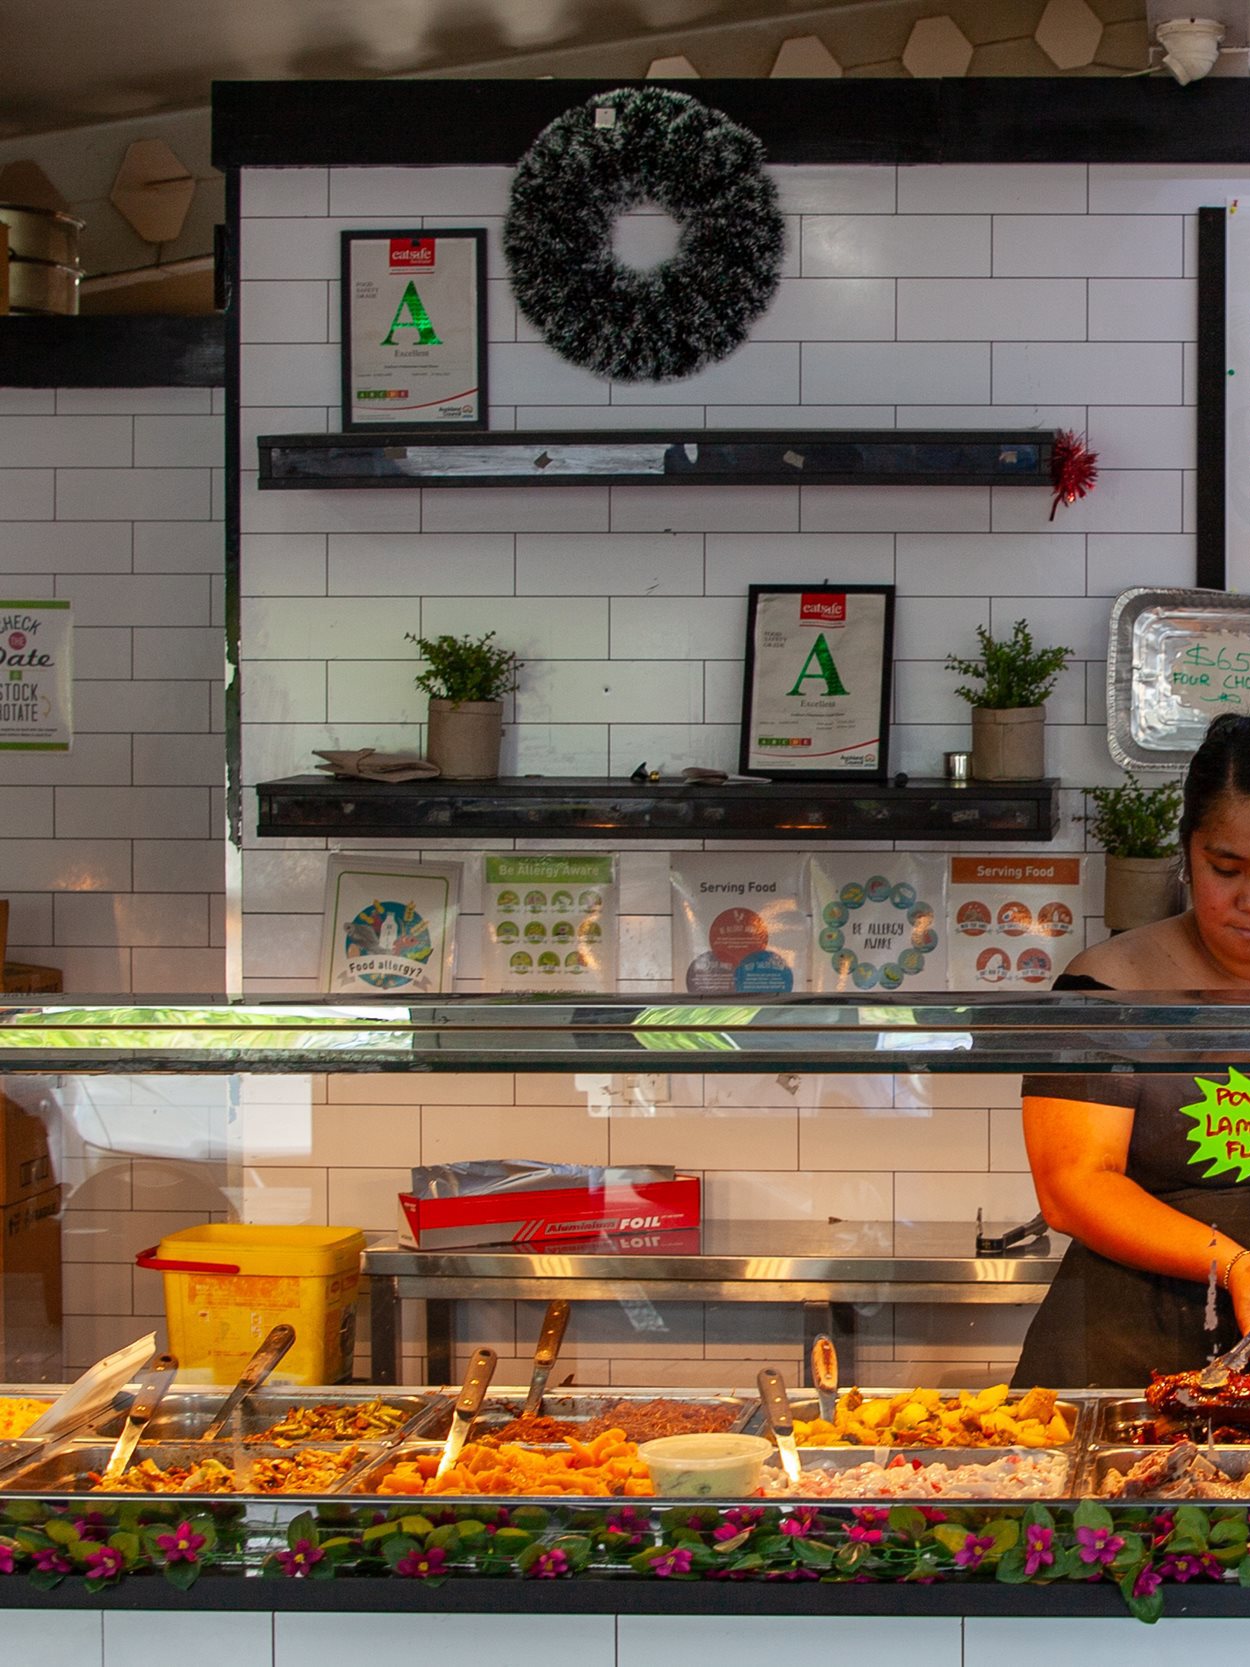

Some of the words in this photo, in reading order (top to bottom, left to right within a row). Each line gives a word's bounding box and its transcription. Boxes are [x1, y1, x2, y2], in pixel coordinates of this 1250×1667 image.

[380, 280, 443, 345] A
[786, 633, 850, 696] A
[1173, 673, 1210, 687] FOUR
[0, 704, 38, 721] OTATE
[499, 865, 514, 875] Be
[517, 863, 560, 877] Allergy
[563, 864, 599, 875] Aware
[977, 866, 1022, 878] Serving
[1026, 866, 1054, 877] Food
[700, 882, 744, 894] Serving
[748, 882, 776, 892] Food
[349, 960, 374, 973] Food
[378, 960, 423, 977] allergy?
[620, 1216, 660, 1229] FOIL
